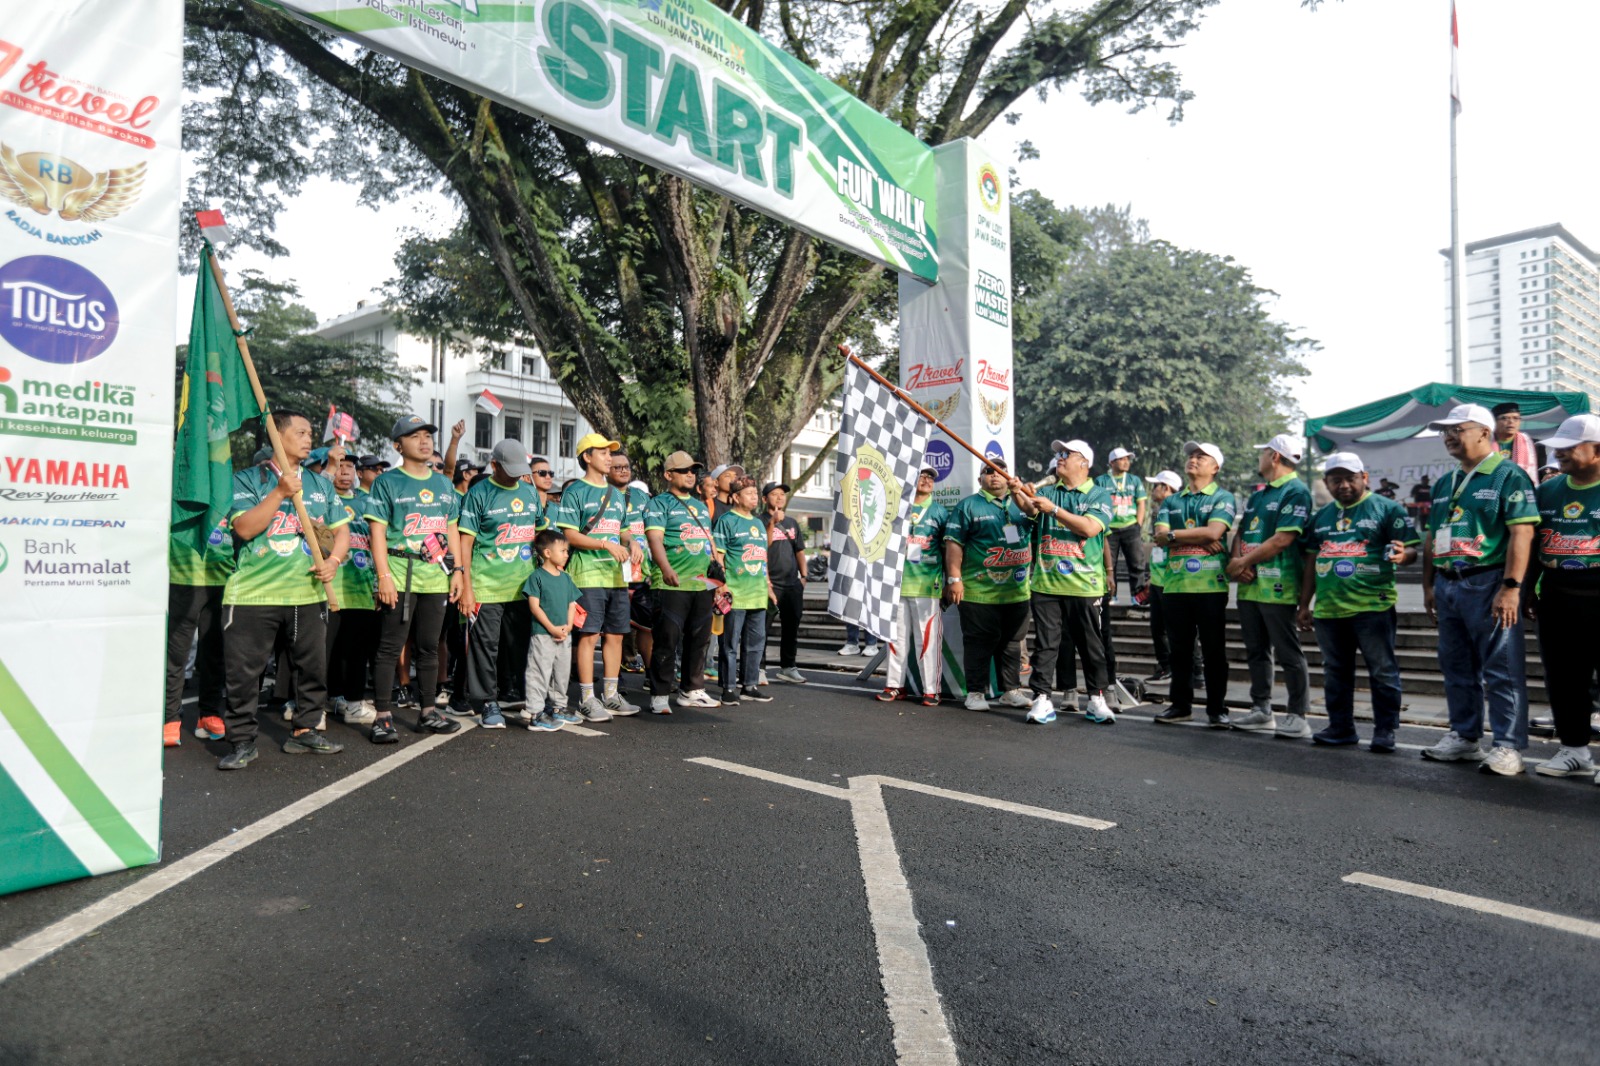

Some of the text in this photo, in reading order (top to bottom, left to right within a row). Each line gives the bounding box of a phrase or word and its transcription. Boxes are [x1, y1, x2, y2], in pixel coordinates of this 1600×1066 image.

[420, 1, 467, 34] Lestari,
[409, 13, 467, 51] Istimewa
[647, 12, 667, 29] LDII
[667, 25, 694, 46] JAWA
[694, 39, 723, 62] BARAT
[665, 4, 746, 65] MUSWIL IX
[19, 61, 160, 130] travel
[537, 0, 803, 200] START
[3, 92, 148, 146] Alhamdulillah Barokah
[38, 158, 73, 186] RB
[837, 155, 873, 209] FUN
[877, 175, 926, 236] WALK
[5, 209, 103, 246] RADJA BAROKAH
[975, 226, 1007, 252] JAWA BARAT
[977, 269, 1005, 297] ZERO
[2, 281, 106, 332] TULUS
[975, 285, 1008, 316] WASTE
[988, 310, 1009, 328] JABAR
[922, 358, 963, 381] travel
[22, 379, 134, 407] medika
[22, 402, 134, 425] antapani
[8, 421, 77, 436] kesehatan
[81, 428, 134, 443] keluarga
[4, 456, 130, 489] YAMAHA
[1400, 464, 1445, 483] FUN
[0, 488, 118, 503] Revs Your Heart
[71, 520, 126, 528] DEPAN
[24, 538, 77, 555] Bank
[24, 559, 131, 575] Muamalat
[97, 579, 131, 588] Syariah
